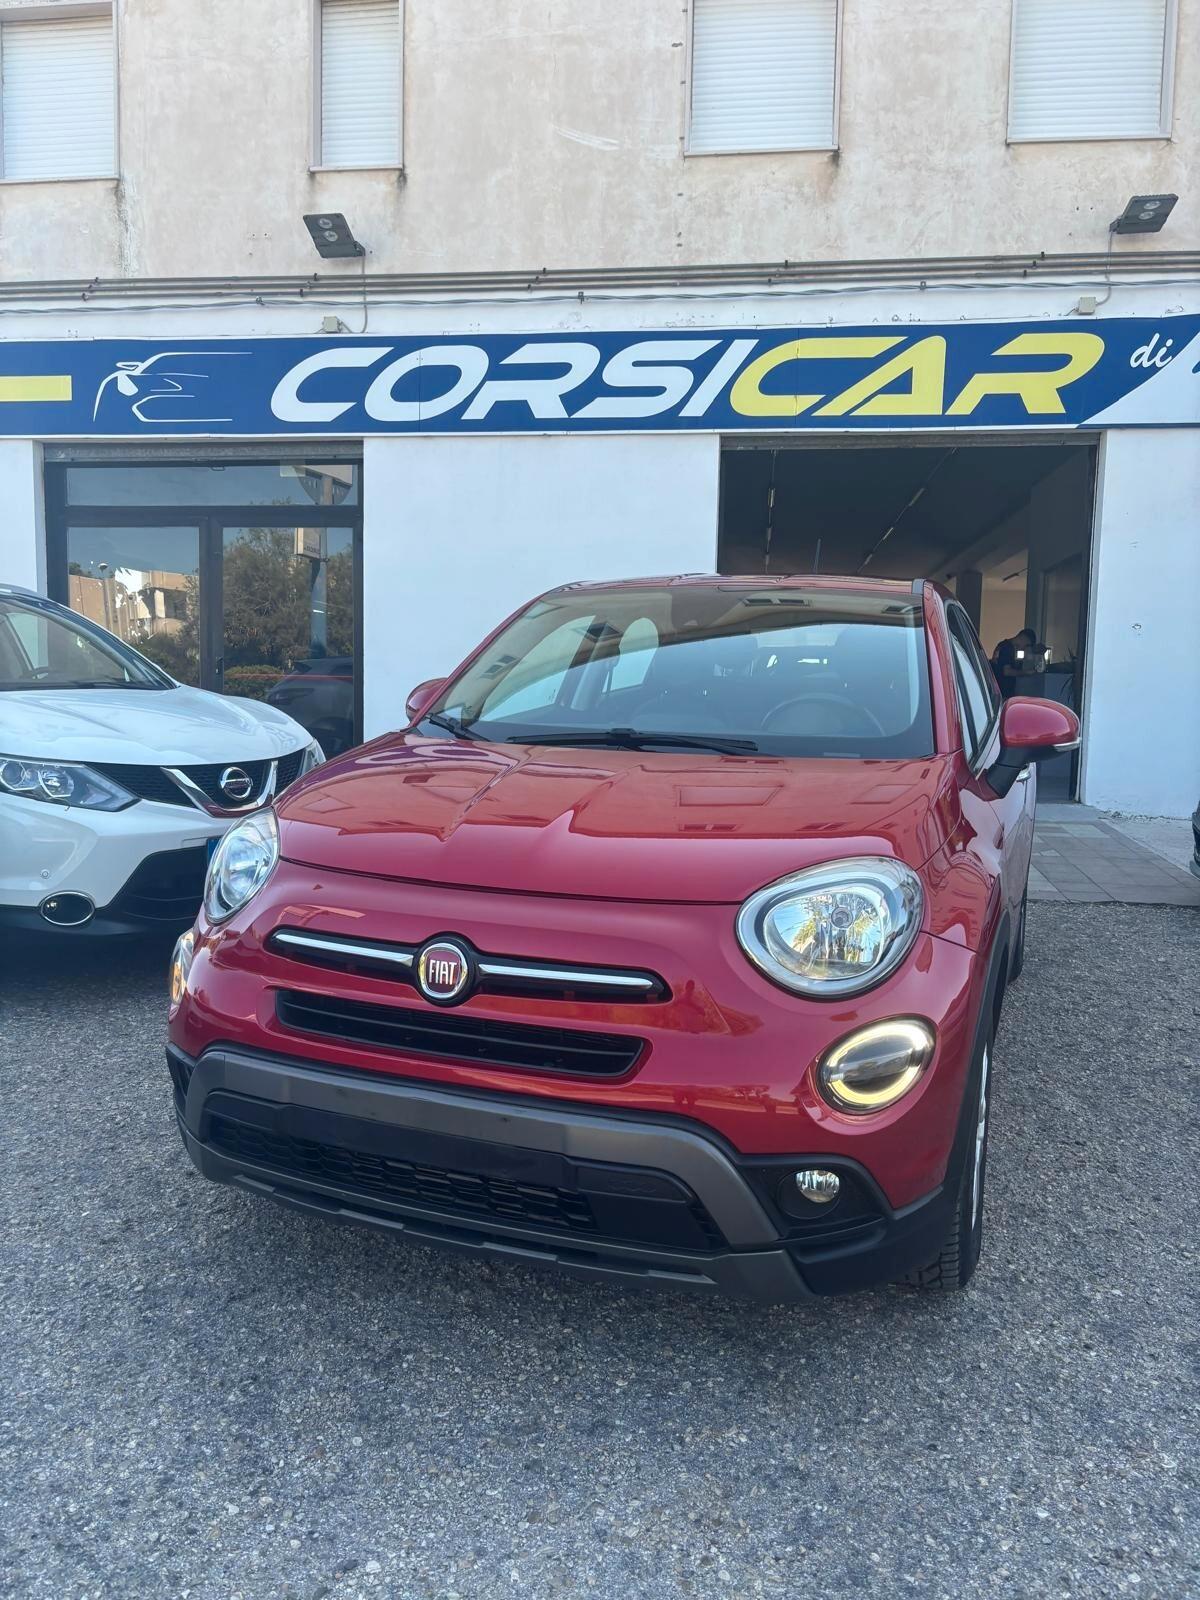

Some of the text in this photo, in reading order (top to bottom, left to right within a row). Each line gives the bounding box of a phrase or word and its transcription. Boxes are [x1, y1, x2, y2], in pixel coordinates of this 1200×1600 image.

[270, 332, 1173, 422] CORSICAR di
[428, 959, 457, 985] FIAT
